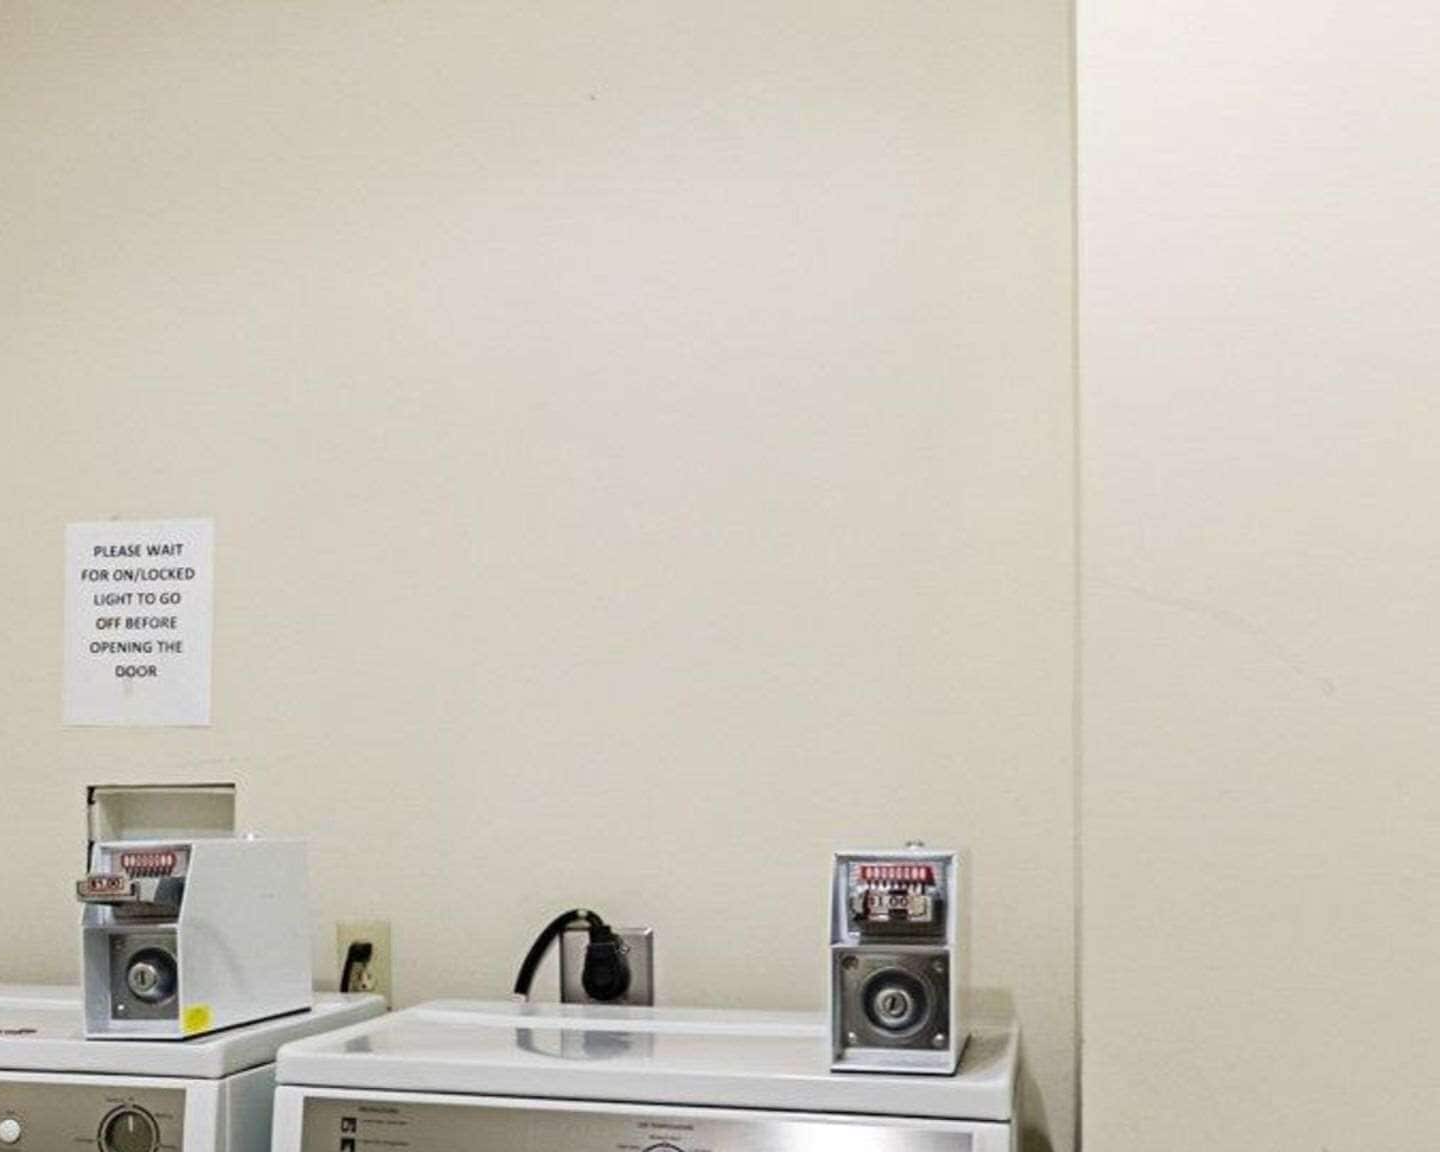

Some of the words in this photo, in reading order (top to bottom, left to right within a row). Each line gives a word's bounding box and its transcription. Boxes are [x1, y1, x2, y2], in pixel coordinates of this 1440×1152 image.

[94, 545, 141, 557] PLEASE
[146, 544, 184, 557] WAIT
[81, 569, 109, 581] FOR
[112, 567, 196, 582] ON/LOCKED
[94, 593, 133, 606] LIGHT
[138, 592, 156, 605] TO
[159, 592, 182, 605] GO
[96, 617, 122, 630] OFF
[125, 616, 178, 630] BEFORE
[89, 641, 153, 654] OPENING
[156, 640, 183, 653] THE
[115, 665, 158, 678] DOOR
